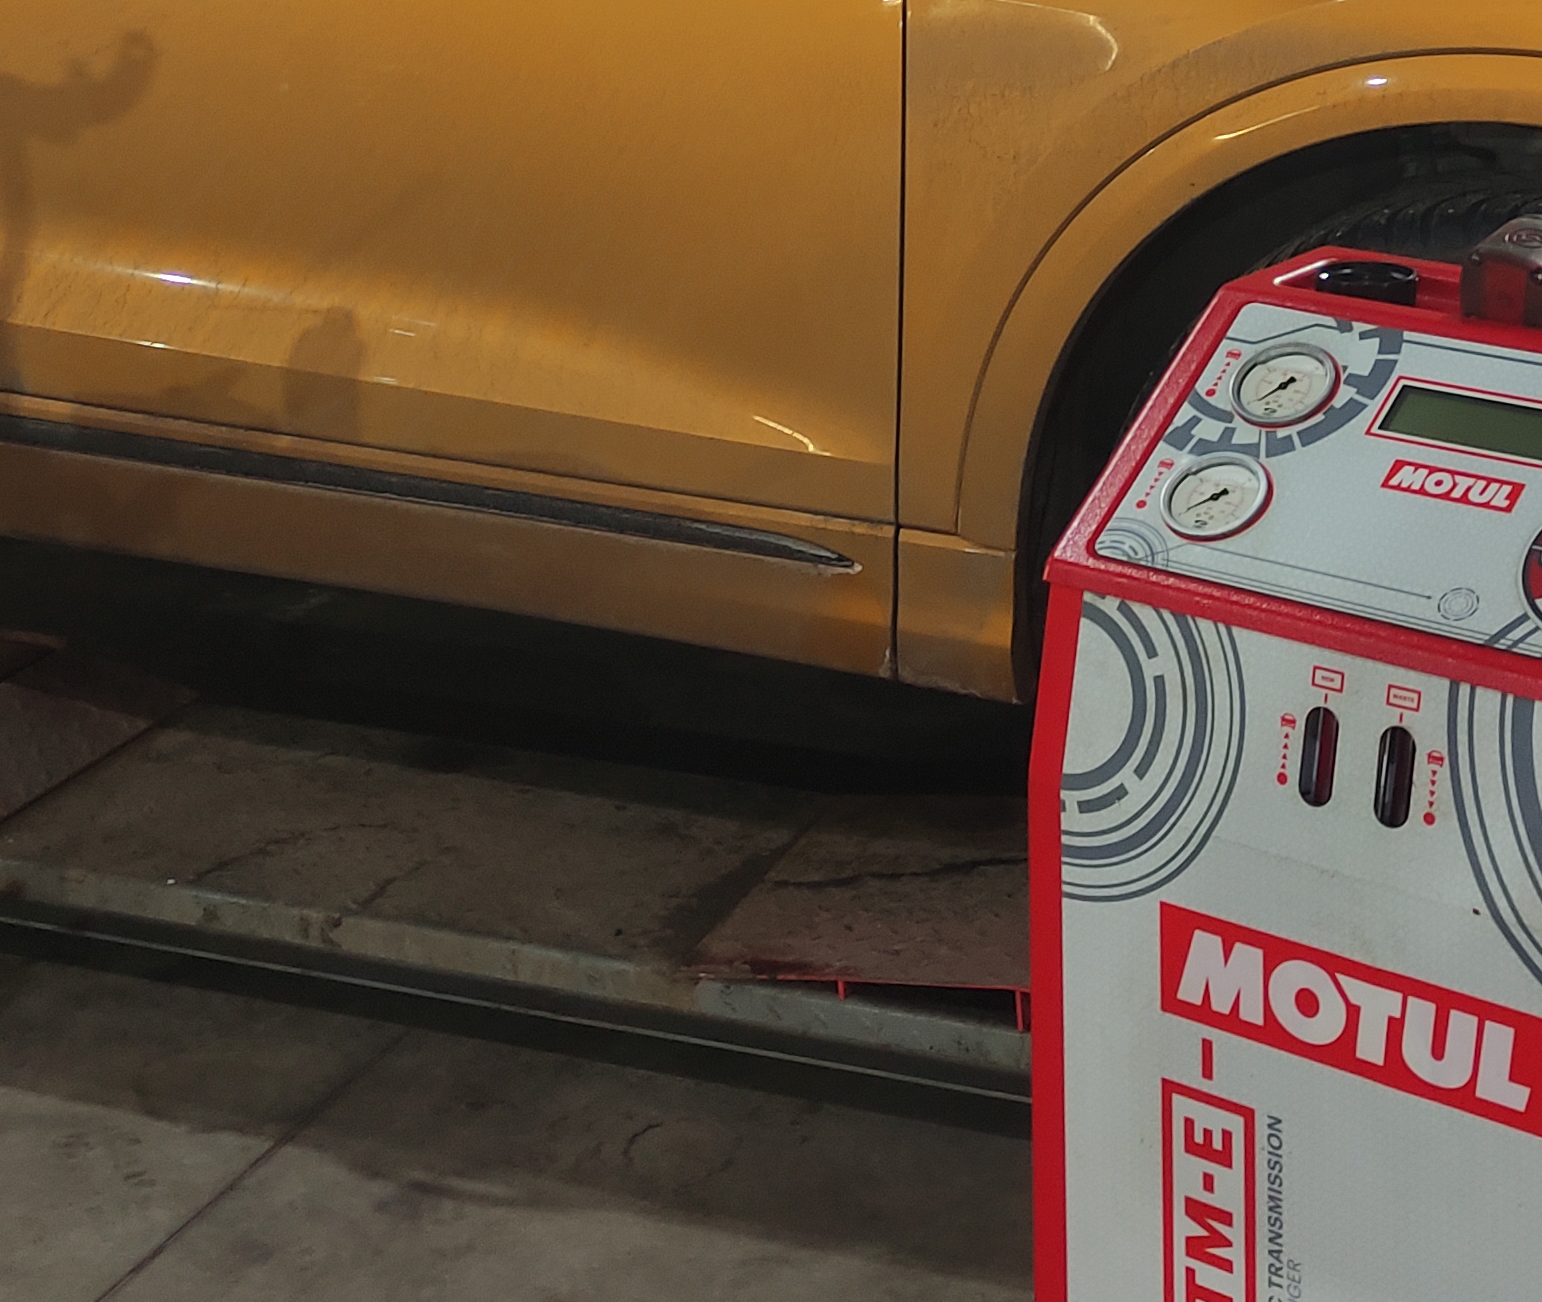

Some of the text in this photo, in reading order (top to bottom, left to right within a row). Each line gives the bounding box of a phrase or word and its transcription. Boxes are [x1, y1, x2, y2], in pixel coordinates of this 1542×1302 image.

[1391, 464, 1514, 507] MOTUL
[1176, 929, 1532, 1113] MOTUL
[1266, 1114, 1285, 1290] TRANSMISSION
[1286, 1259, 1303, 1302] GER
